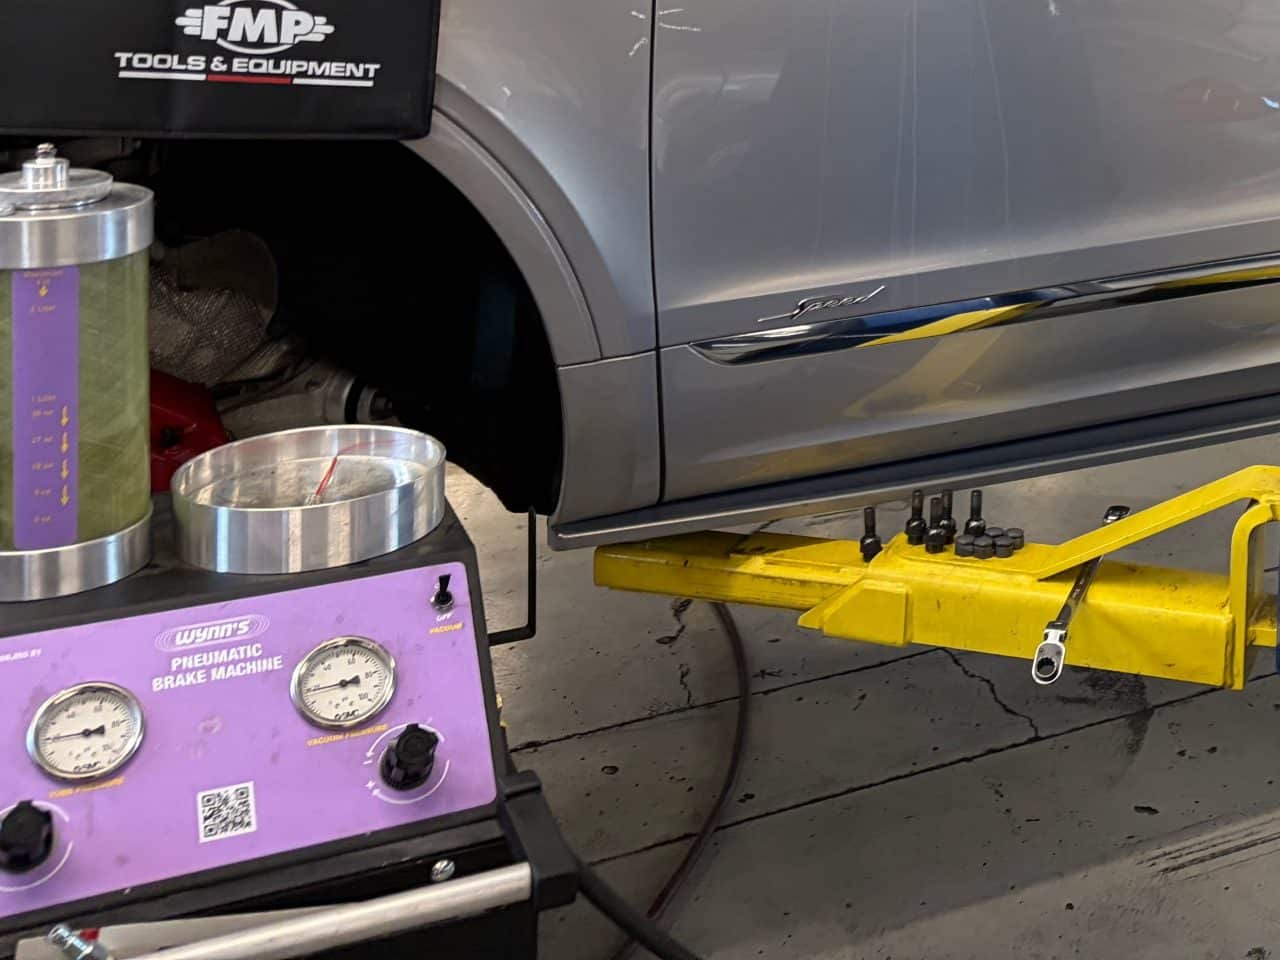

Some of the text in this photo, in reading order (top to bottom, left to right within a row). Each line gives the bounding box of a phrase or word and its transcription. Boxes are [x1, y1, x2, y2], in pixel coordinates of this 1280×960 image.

[201, 5, 315, 44] FMP
[113, 52, 381, 78] TOOLS & EQUIPMENT
[758, 285, 886, 321] Speed
[151, 655, 284, 692] BRAKE MACHINE
[170, 643, 263, 672] PNEUMATIC
